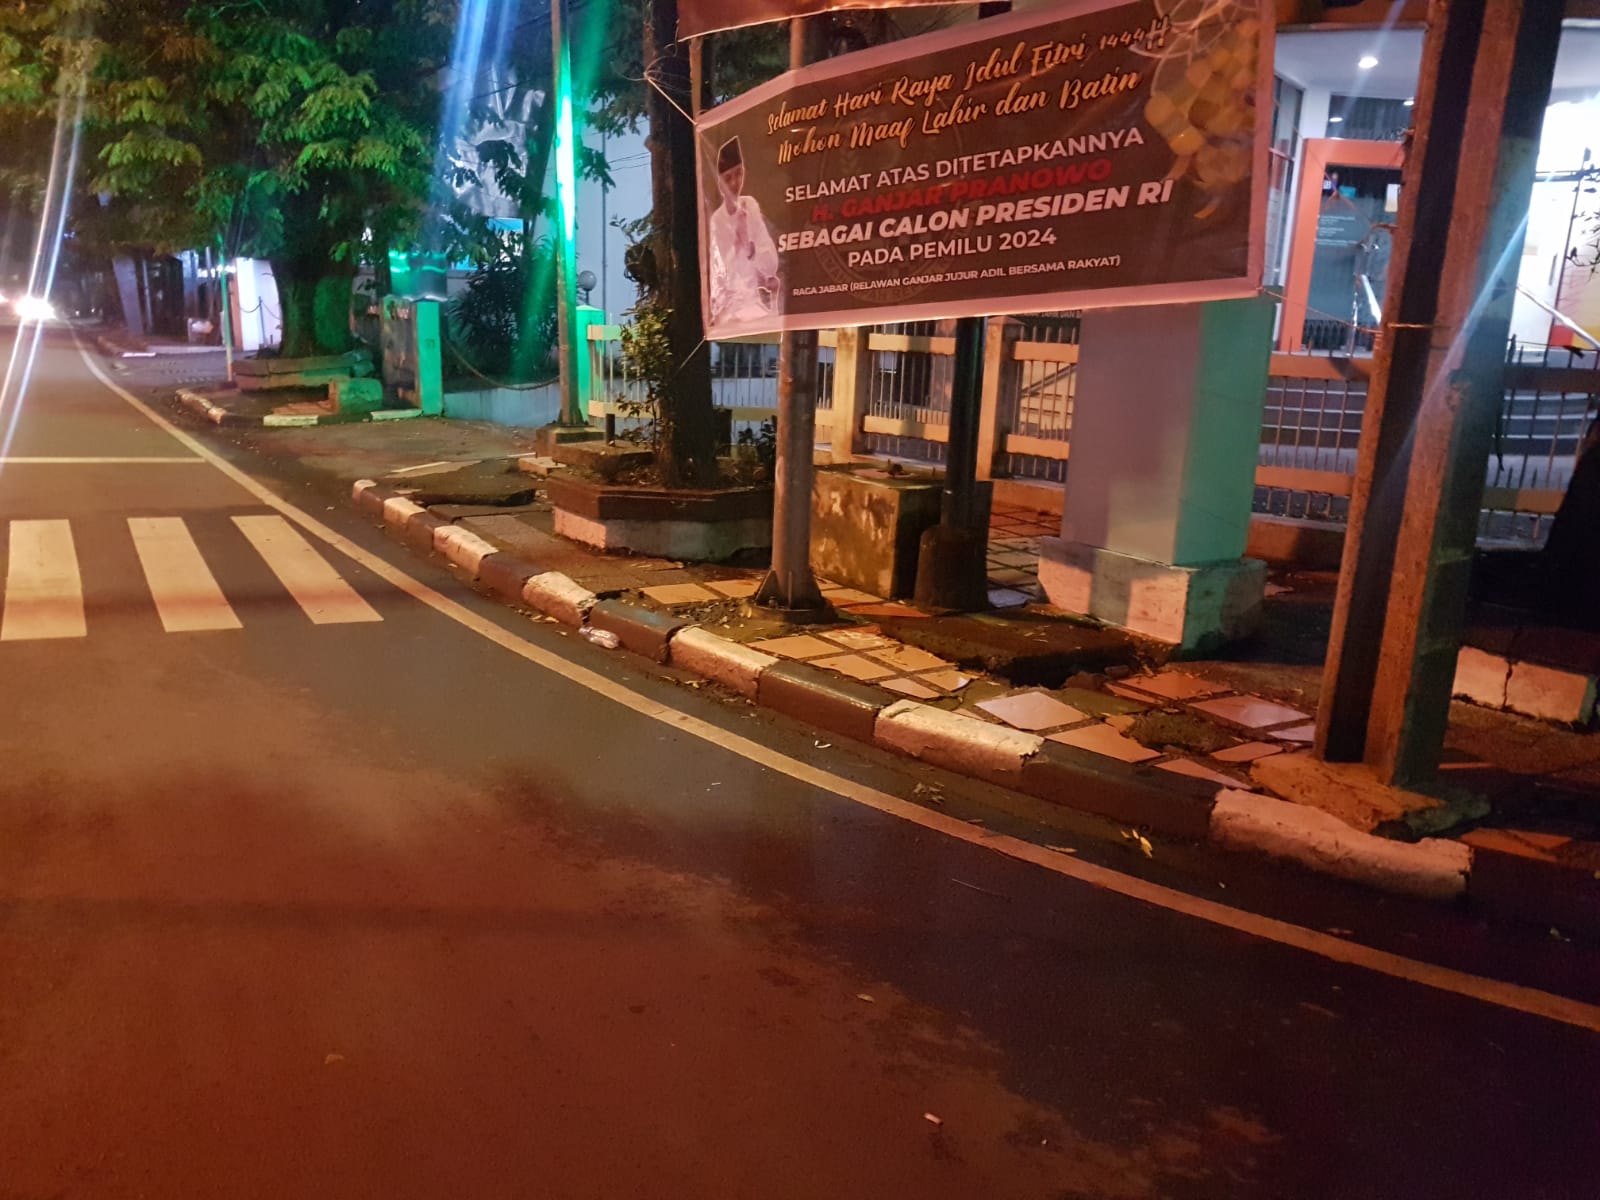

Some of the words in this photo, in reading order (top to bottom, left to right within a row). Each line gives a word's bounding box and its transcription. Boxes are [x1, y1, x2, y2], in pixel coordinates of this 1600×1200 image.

[768, 99, 828, 135] Selamat
[834, 82, 882, 118] Hari
[891, 73, 953, 107] Raya
[963, 41, 1026, 91] Idul
[1031, 33, 1087, 77] Fitri
[778, 126, 841, 165] Mohon
[850, 117, 915, 149] Maaf
[921, 94, 987, 134] Lahir
[995, 81, 1047, 116] dan
[1059, 66, 1141, 109] Batin
[785, 173, 872, 203] SELAMAT
[876, 163, 930, 188] ATAS
[935, 127, 1144, 178] DITETAPKANNYA
[841, 185, 943, 218] GANJAR
[947, 158, 1112, 202] PRANOWO
[778, 221, 874, 253] SEBAGAI
[879, 207, 970, 238] CALON
[975, 185, 1130, 226] PRESIDEN
[1136, 179, 1175, 206] RI
[848, 245, 904, 268] PADA
[909, 235, 993, 261] PEMILU
[999, 227, 1057, 250] 2024
[792, 287, 818, 297] RAGA
[818, 283, 849, 293] JABAR
[850, 278, 901, 292] (RELAWAN
[901, 273, 943, 286] GANJAR
[944, 270, 978, 282] JUJUR
[980, 267, 1006, 278] ADIL
[1008, 261, 1065, 276] BERSAMA
[1067, 254, 1121, 270] RAKYAT)
